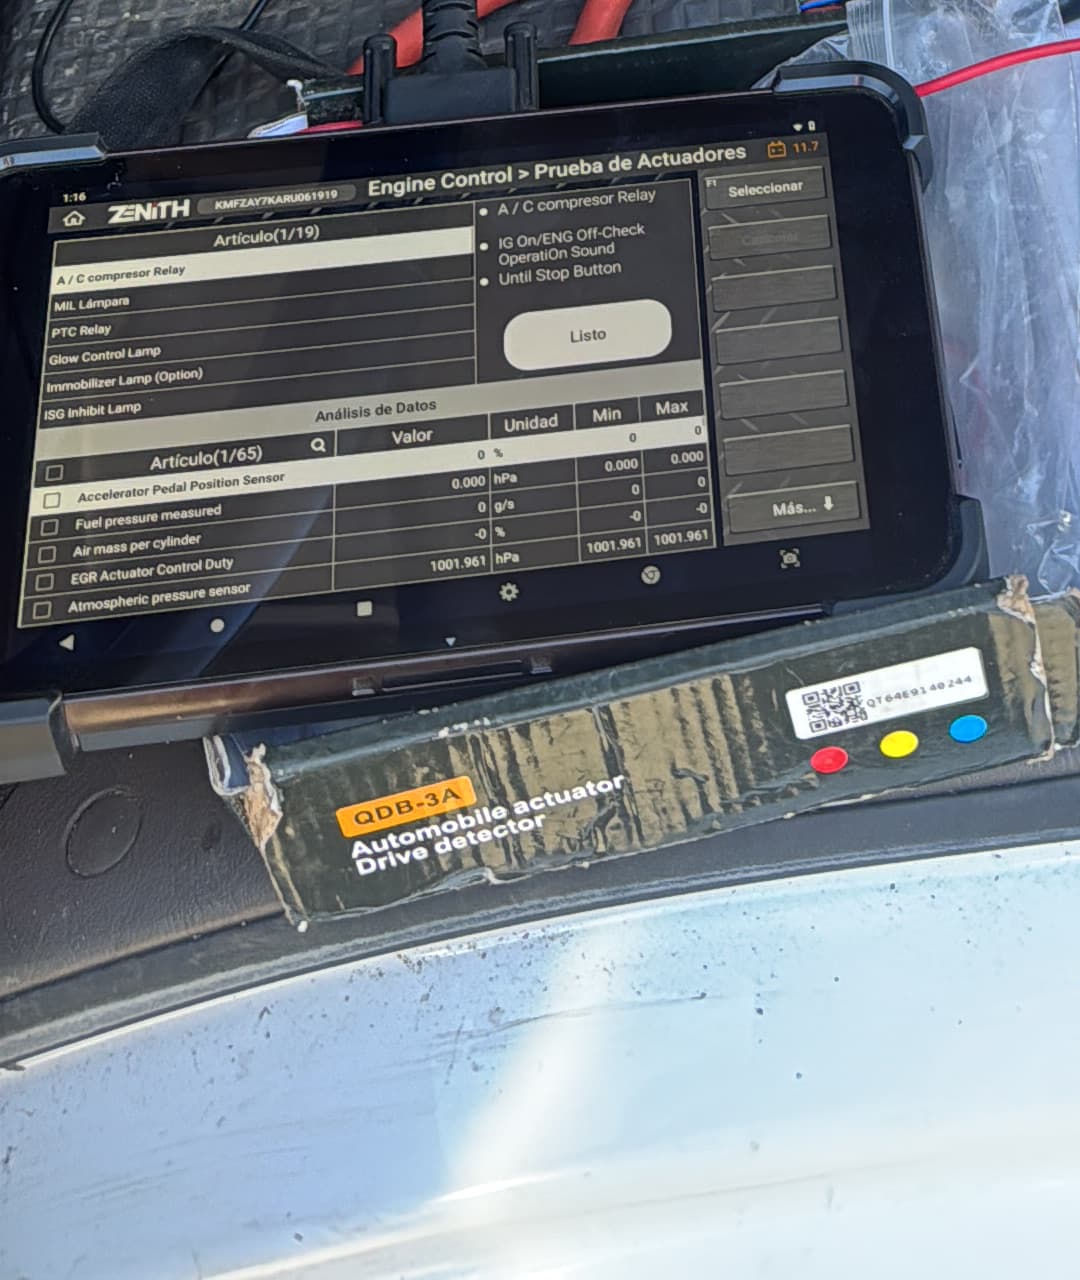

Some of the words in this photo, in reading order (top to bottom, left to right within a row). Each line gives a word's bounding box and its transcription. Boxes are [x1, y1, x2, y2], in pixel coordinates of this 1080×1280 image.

[792, 141, 819, 153] 11.7
[368, 174, 436, 197] Engine
[441, 167, 513, 188] Control
[534, 158, 604, 180] Prueba
[608, 155, 633, 173] de
[637, 146, 748, 169] Actuadores
[63, 192, 87, 203] 1:16
[728, 180, 804, 198] Seleccionar
[498, 203, 509, 216] A
[523, 199, 534, 214] C
[537, 194, 614, 213] compresor
[618, 188, 657, 204] Relay
[213, 224, 321, 247] Artículo(1/19)
[499, 236, 514, 250] IG
[517, 230, 573, 250] On/ENG
[576, 223, 645, 243] Off-Check
[498, 247, 568, 267] OperatiOn
[571, 242, 616, 258] Sound
[57, 276, 66, 286] A
[76, 273, 85, 284] C
[88, 268, 151, 283] compresor
[153, 264, 186, 278] Relay
[499, 270, 532, 286] Until
[535, 267, 570, 284] Stop
[573, 261, 622, 279] Button
[54, 300, 77, 312] MIL
[51, 326, 77, 339] PTC
[80, 323, 112, 337] Relay
[570, 328, 607, 344] Listo
[49, 353, 79, 366] Glow
[82, 348, 126, 363] Control
[128, 345, 161, 360] Lamp
[46, 377, 116, 393] Immobilizer
[119, 373, 153, 388] Lamp
[154, 367, 204, 385] (Option)
[44, 409, 65, 421] ISG
[68, 404, 106, 418] Inhibit
[108, 401, 142, 416] Lamp
[314, 406, 371, 423] Análisis
[374, 403, 393, 417] de
[396, 400, 437, 415] Datos
[149, 445, 263, 471] Artículo(1/65)
[391, 429, 433, 445] Valor
[503, 413, 560, 433] Unidad
[592, 407, 622, 423] Min
[655, 401, 689, 416] Max
[77, 486, 150, 503] Accelerator
[152, 481, 187, 496] Pedal
[190, 476, 240, 492] Position
[243, 472, 286, 487] Sensor
[477, 449, 486, 461] 0
[629, 433, 637, 443] 0
[694, 425, 702, 435] 0
[75, 517, 103, 532] Fuel
[105, 511, 158, 529] pressure
[161, 504, 222, 521] measured
[451, 475, 486, 490] 0.000
[493, 472, 518, 485] hPa
[604, 458, 639, 472] 0.000
[670, 451, 704, 466] 0.000
[73, 545, 91, 558] Air
[93, 542, 128, 556] mass
[130, 540, 151, 554] per
[153, 534, 202, 551] cylinder
[477, 502, 487, 513] 0
[494, 499, 515, 514] g/s
[631, 483, 640, 495] 0
[697, 477, 706, 488] 0
[772, 499, 817, 517] Más...
[70, 573, 98, 586] EGR
[100, 566, 154, 583] Actuator
[157, 560, 203, 576] Control
[205, 557, 234, 571] Duty
[474, 527, 487, 540] -0
[629, 510, 642, 522] -0
[695, 503, 708, 514] -0
[68, 593, 149, 614] Atmospheric
[151, 588, 206, 605] pressure
[208, 582, 251, 597] sensor
[430, 555, 487, 572] 1001.961
[495, 552, 520, 564] hPa
[586, 537, 642, 554] 1001.961
[653, 529, 709, 546] 1001.961
[351, 805, 508, 859] Automobile
[512, 774, 625, 815] actuator
[353, 786, 462, 826] QDB-3A
[355, 845, 430, 877] Drive
[434, 813, 547, 855] detector
